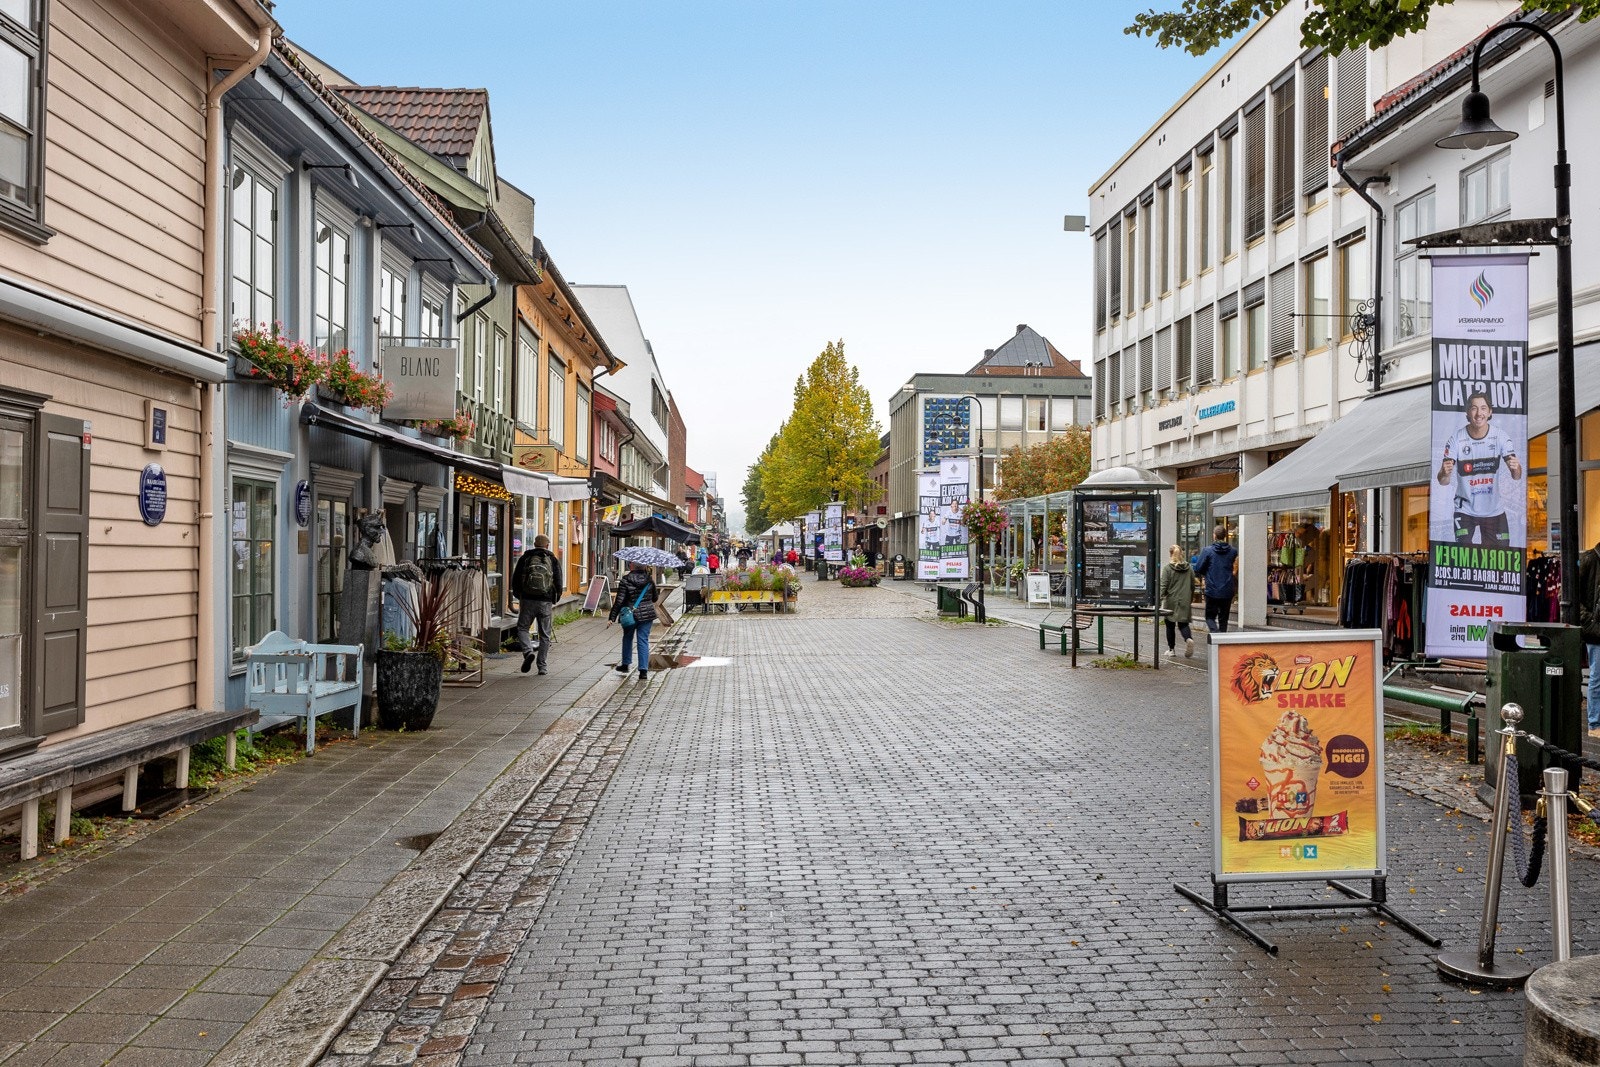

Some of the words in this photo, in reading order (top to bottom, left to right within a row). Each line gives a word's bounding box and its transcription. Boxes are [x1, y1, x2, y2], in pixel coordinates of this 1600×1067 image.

[401, 356, 440, 377] BLANC
[1198, 400, 1236, 420] LILLEHAMMER
[942, 484, 967, 497] ELVERUM
[1274, 655, 1357, 692] LION
[1277, 693, 1346, 708] SHAKE
[1331, 754, 1366, 763] DIGG!
[1265, 817, 1311, 833] LION
[1329, 814, 1340, 826] 2
[1280, 846, 1315, 858] MIX
